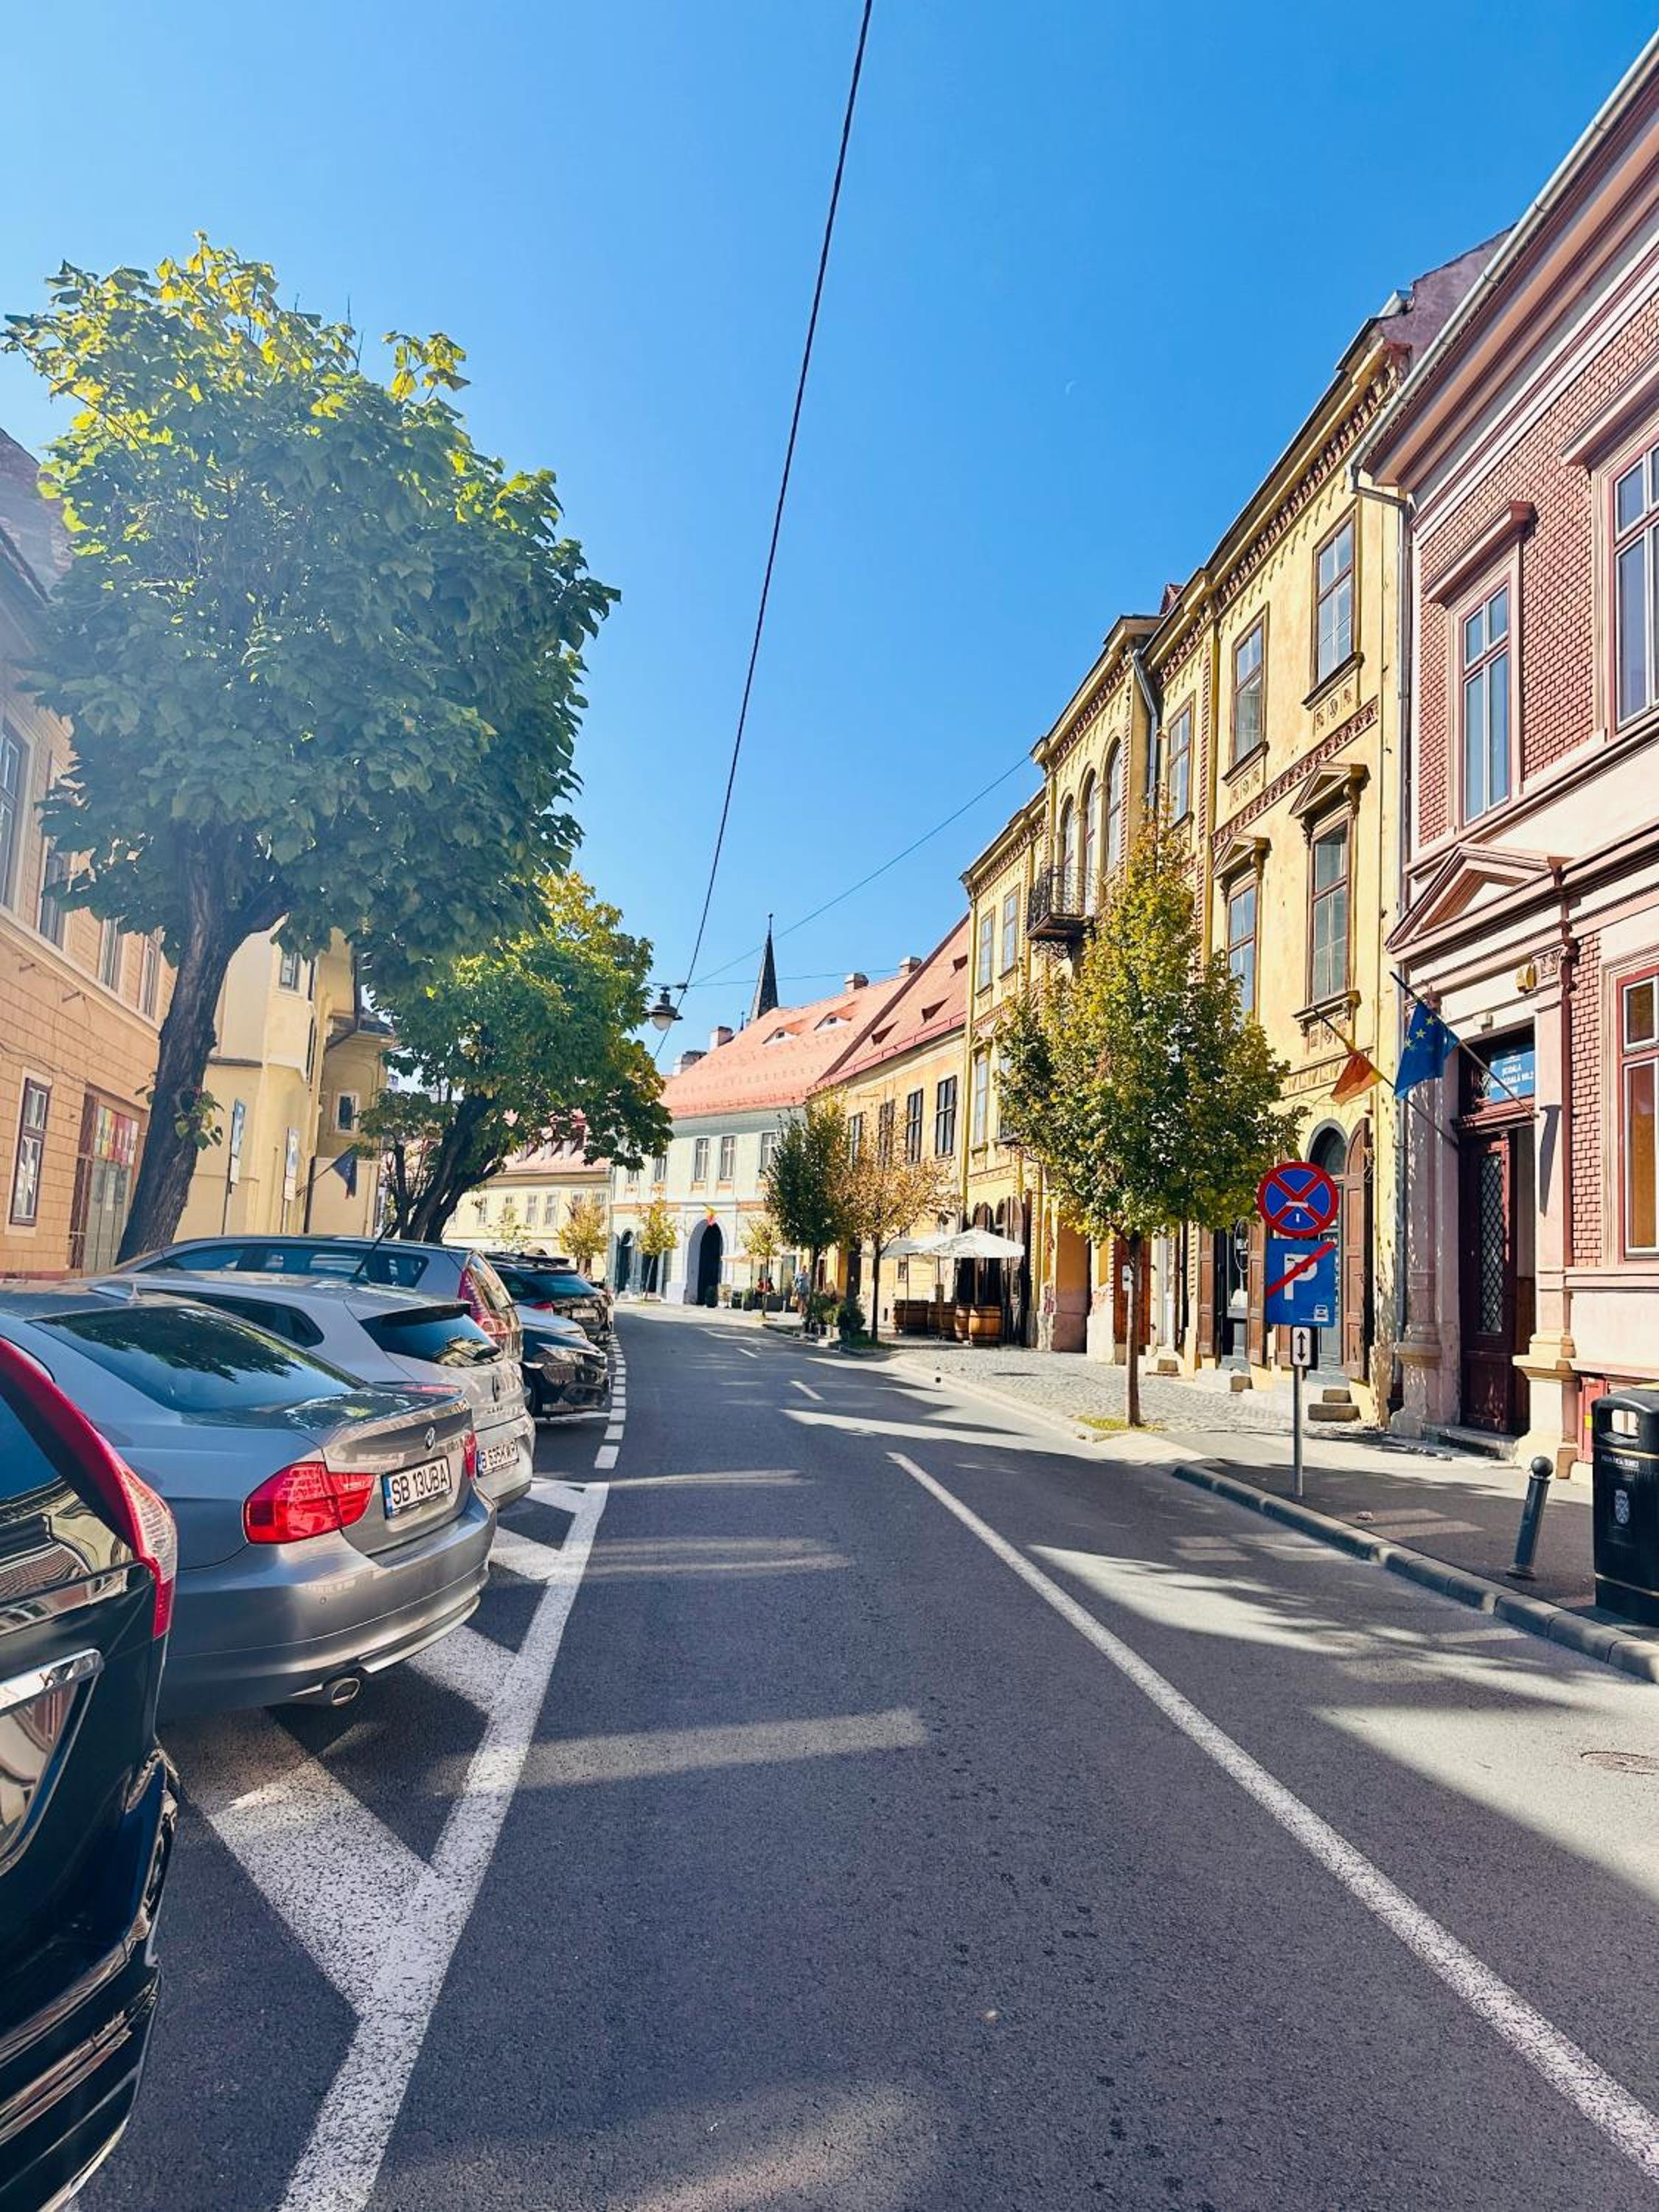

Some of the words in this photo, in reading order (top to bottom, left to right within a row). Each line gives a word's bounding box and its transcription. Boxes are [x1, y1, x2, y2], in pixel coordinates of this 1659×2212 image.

[1284, 1253, 1318, 1300] P
[392, 1475, 410, 1505] SB
[413, 1463, 448, 1498] 13UBA
